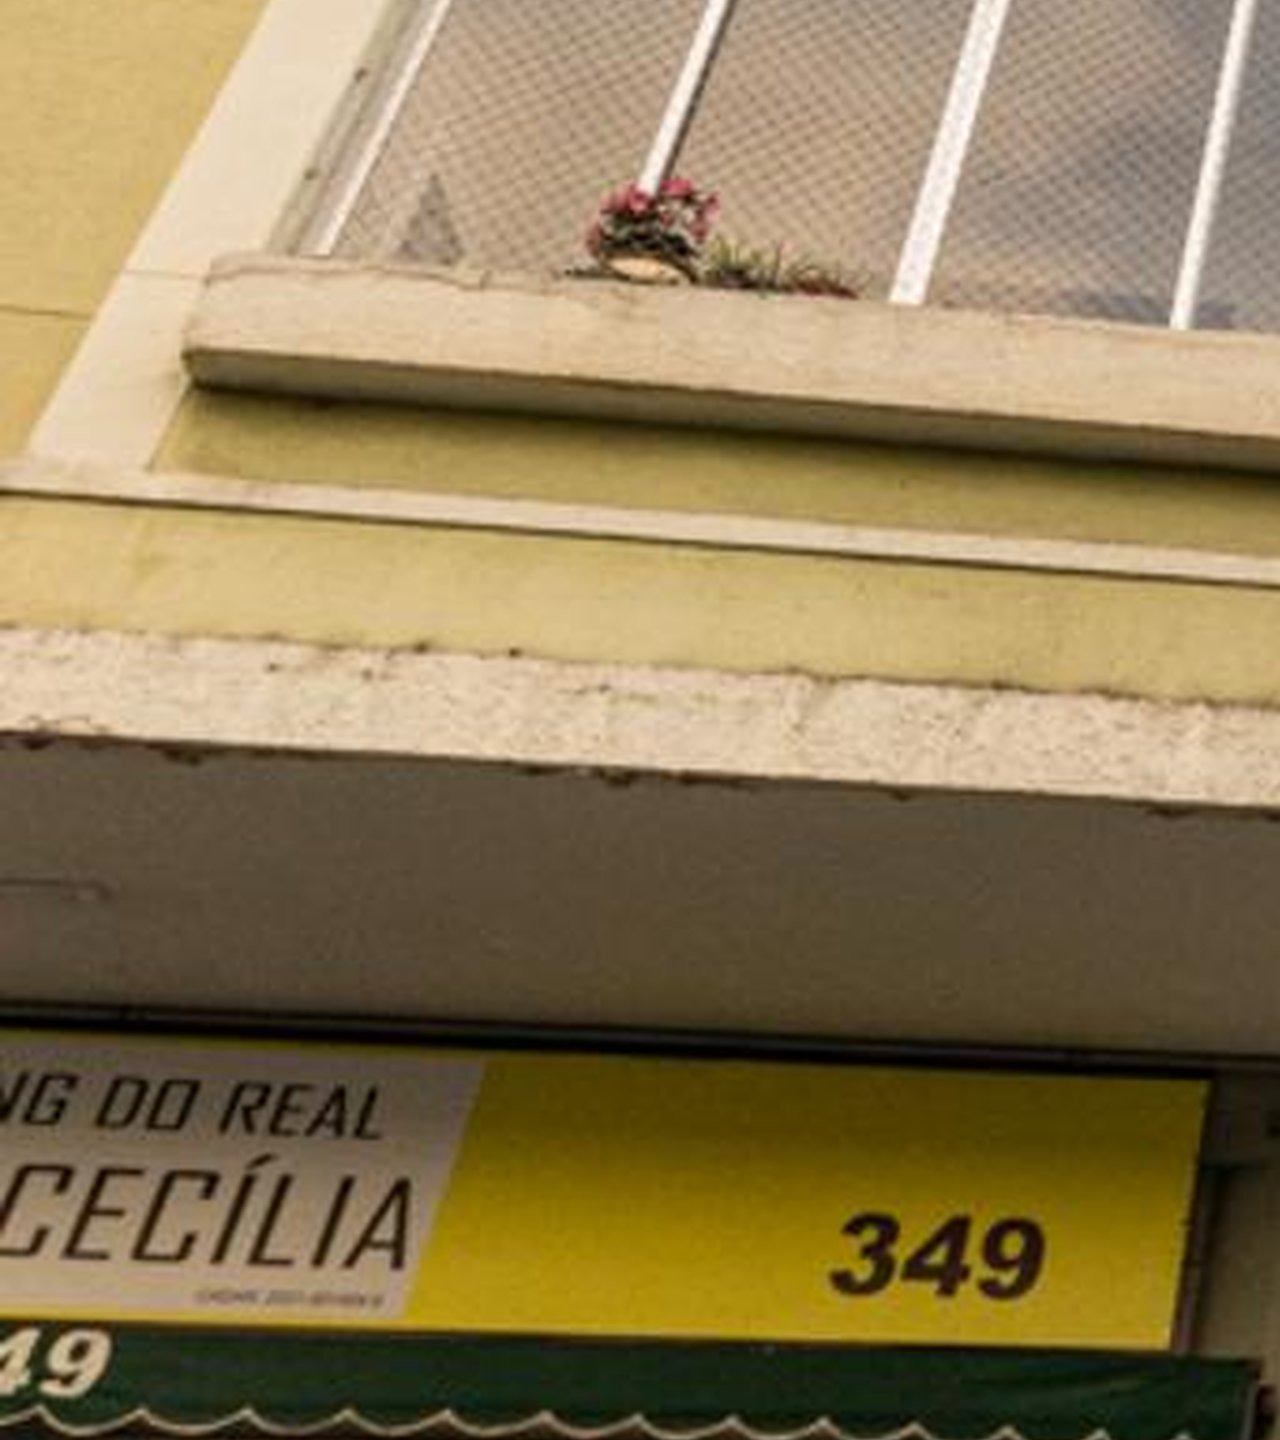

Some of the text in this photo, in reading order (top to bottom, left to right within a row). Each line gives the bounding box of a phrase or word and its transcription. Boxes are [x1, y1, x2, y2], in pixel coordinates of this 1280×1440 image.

[95, 1075, 201, 1131] DO
[218, 1080, 387, 1140] REAL
[0, 1152, 412, 1270] CECÍLIA
[828, 1211, 1046, 1301] 349
